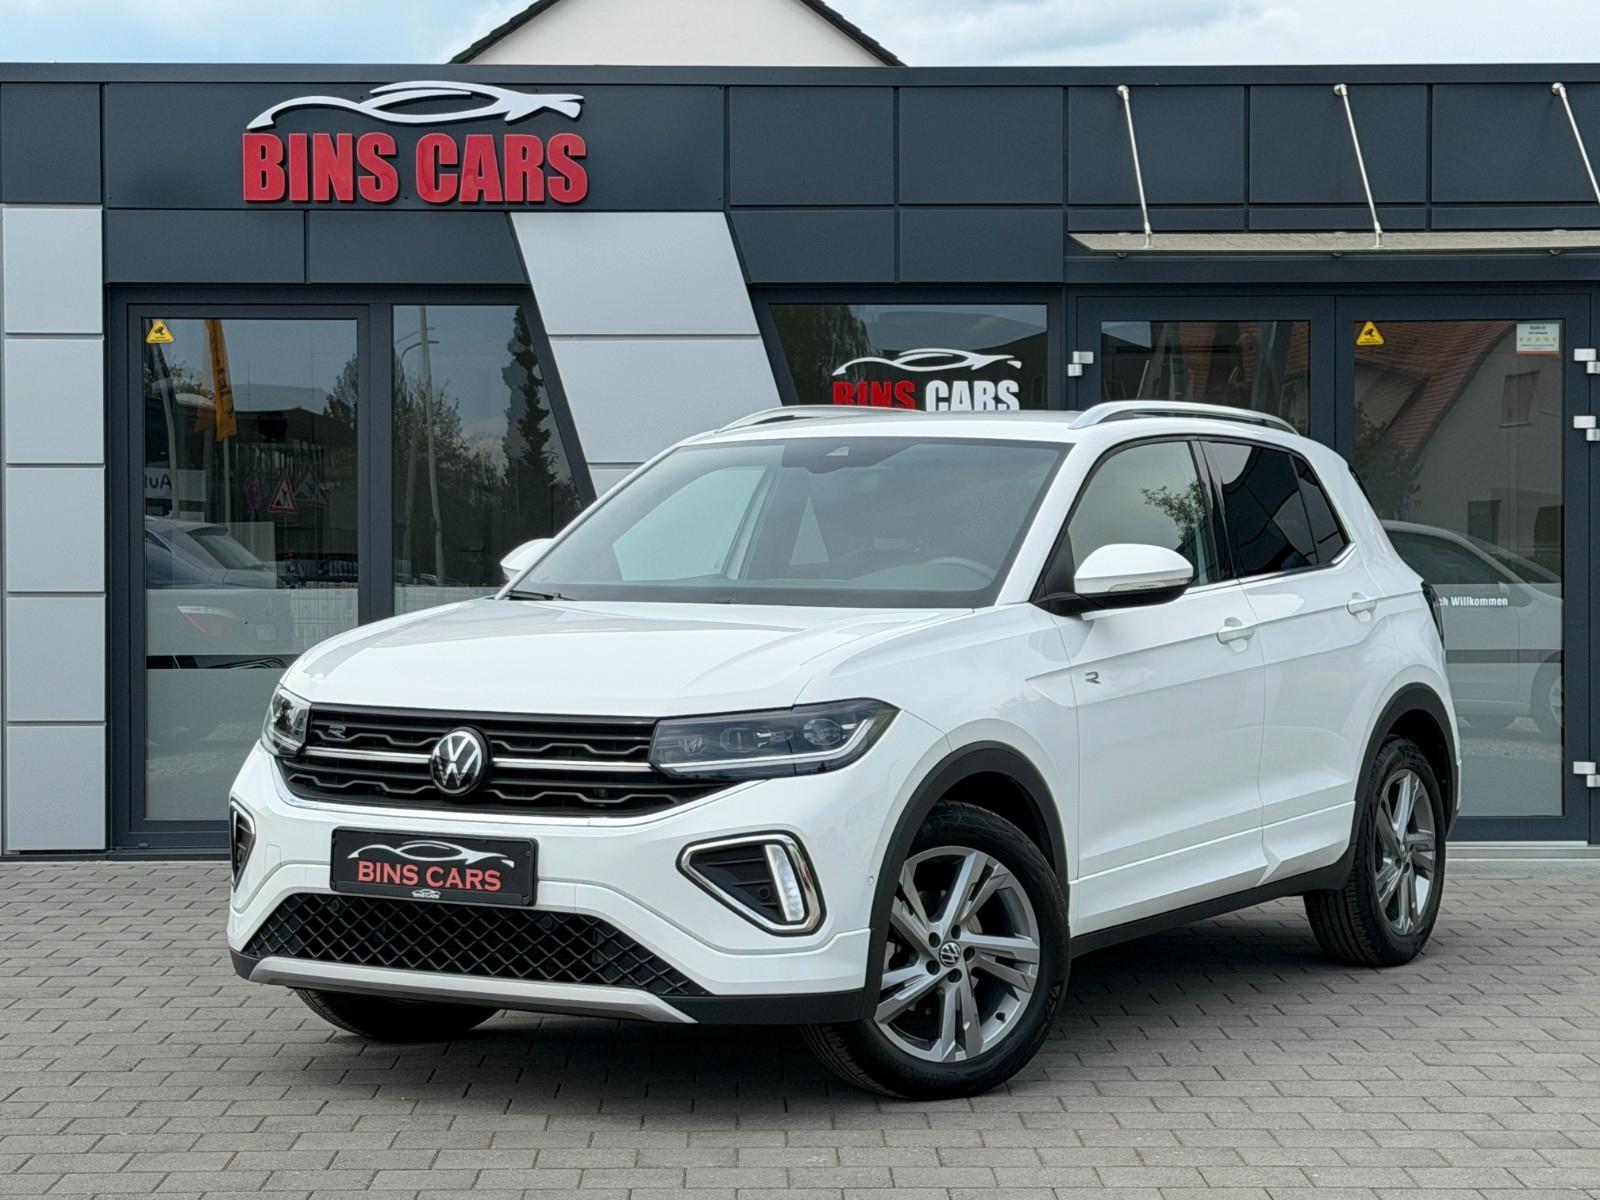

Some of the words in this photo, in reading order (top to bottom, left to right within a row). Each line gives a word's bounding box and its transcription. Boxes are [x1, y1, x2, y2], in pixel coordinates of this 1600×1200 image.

[242, 133, 399, 203] BINS
[416, 133, 588, 203] CARS
[832, 380, 916, 409] BINS
[925, 380, 1019, 412] CARS
[1451, 596, 1509, 607] Willkommen
[358, 861, 419, 886] BINS
[425, 866, 502, 891] CARS
